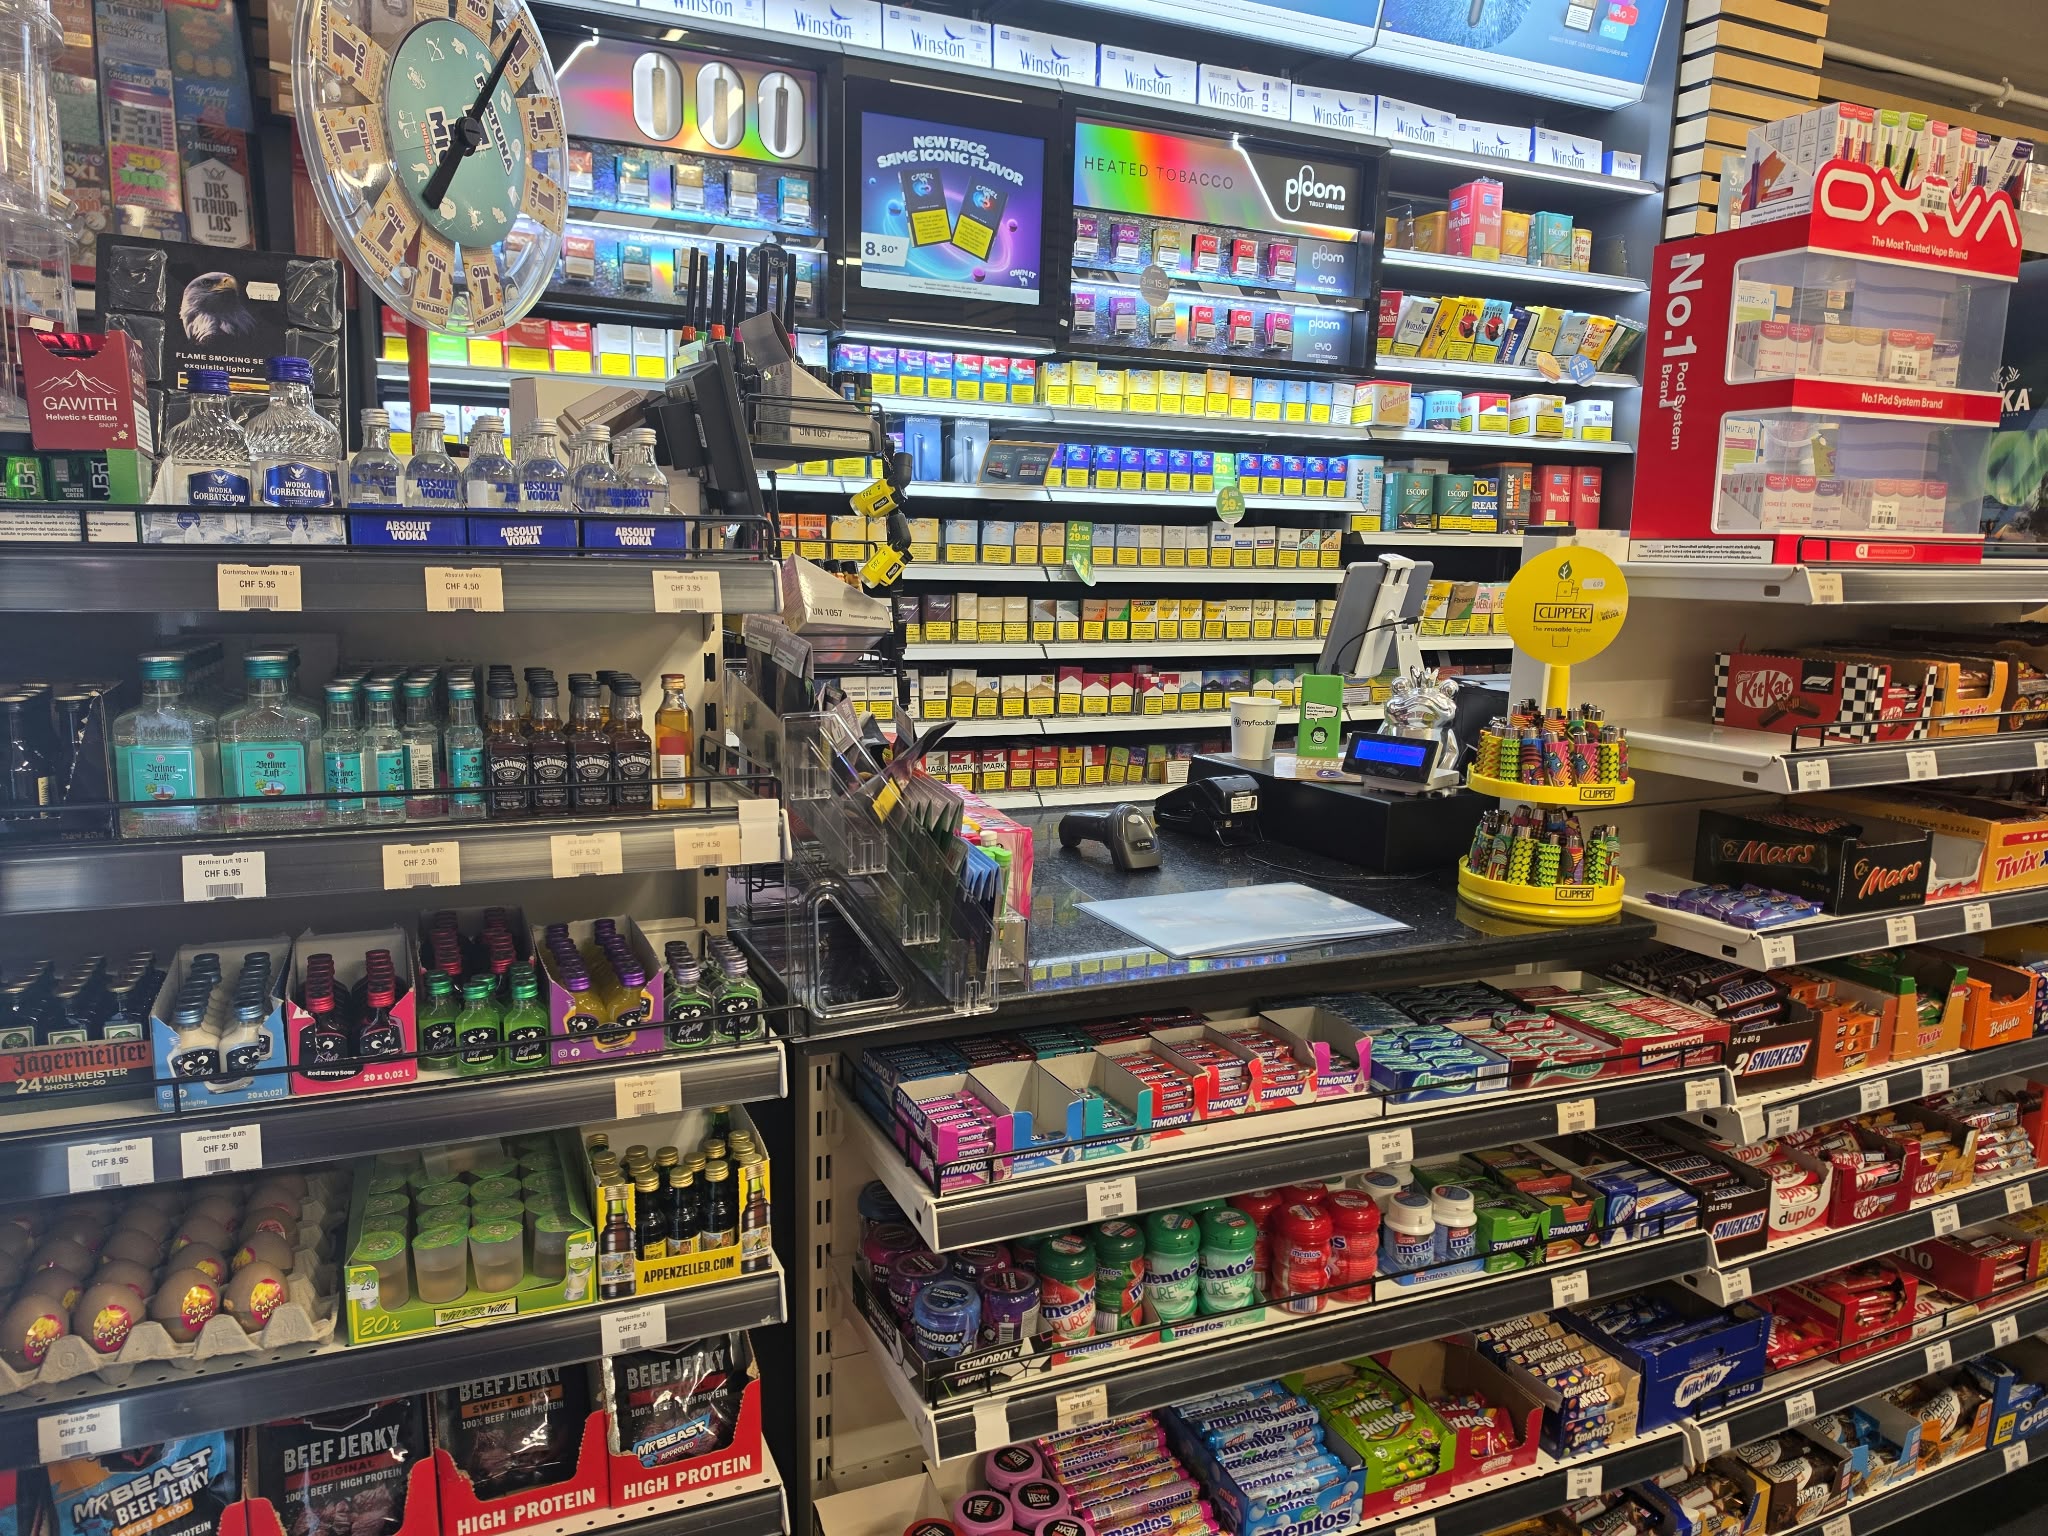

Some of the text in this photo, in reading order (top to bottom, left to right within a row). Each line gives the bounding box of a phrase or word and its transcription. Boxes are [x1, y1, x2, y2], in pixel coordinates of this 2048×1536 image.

[794, 10, 852, 39] Winston
[332, 30, 366, 78] 1 MIO
[911, 29, 965, 59] Winston
[1124, 68, 1171, 96] Winston
[1208, 83, 1254, 110] Winston
[1396, 116, 1435, 143] Winston
[187, 141, 238, 154] 2 MILLIONEN
[913, 136, 989, 159] NEW FACE,
[1552, 146, 1585, 168] Winston
[877, 150, 1024, 186] SAME ICONIC FLAVOR
[1084, 156, 1234, 190] HEATED TOBACCO
[204, 182, 229, 199] DAS
[976, 184, 998, 200] CAMEL
[192, 197, 243, 217] TRAUM-
[208, 215, 231, 233] LOS
[386, 202, 406, 234] MIO
[1871, 236, 1969, 261] The Most Trusted Vape Brand
[1028, 271, 1037, 279] IT
[1318, 275, 1336, 285] evo
[175, 352, 207, 361] FLAME
[209, 354, 249, 363] SMOKING
[184, 363, 254, 374] exquisite lighter
[1659, 364, 1675, 409] Brand
[43, 397, 118, 411] GAWITH
[1670, 362, 1689, 451] Pod System
[1861, 391, 1943, 410] No.1 Pod System Brand
[46, 413, 80, 421] Helvetic
[269, 487, 326, 499] GORBATSCHOW
[285, 481, 311, 489] WODKA
[1447, 489, 1469, 498] ESCORT
[1506, 474, 1515, 510] BLACK
[193, 491, 246, 503] GORBATSCHOW
[386, 521, 431, 532] ABSOLUT
[390, 529, 427, 541] VODKA
[500, 525, 543, 537] ABSOLUT
[615, 526, 656, 537] ABSOLUT
[1071, 524, 1078, 532] 4
[505, 535, 540, 546] VODKA
[619, 536, 652, 546] VODKA
[1069, 533, 1090, 541] 29.90
[239, 580, 276, 589] CHF 5.95
[812, 608, 842, 617] UN 1057
[1539, 607, 1587, 619] CLIPPER
[1741, 672, 1791, 708] KitKat
[534, 759, 546, 770] JACK
[950, 763, 973, 772] MARK
[983, 762, 1006, 771] MARK
[1583, 789, 1613, 798] CLIPPER
[403, 858, 438, 867] CHF 2.50
[1738, 840, 1817, 865] Mars
[204, 868, 241, 878] CHF 6.95
[1996, 850, 2040, 882] Twix
[1859, 861, 1922, 899] Mars
[1559, 890, 1591, 898] CLIPPER
[1989, 1015, 2021, 1038] Balisto
[1917, 1028, 1943, 1046] Twix
[13, 1041, 146, 1076] Jägermeister
[862, 1051, 893, 1082] STIMOROL
[1734, 1044, 1807, 1076] 2 SNICKERS
[15, 1067, 128, 1094] 24 MINI MEISTER
[44, 1078, 106, 1092] SHOTS-TO-GO
[896, 1092, 925, 1125] STIMOROL
[91, 1156, 129, 1168] CHF 8.95
[1779, 1206, 1817, 1225] duplo
[1714, 1214, 1762, 1240] SNICKERS
[643, 1256, 734, 1284] APPENZELLER.COM
[1143, 1256, 1199, 1283] mentos
[618, 1322, 647, 1334] CHF 2.50
[915, 1324, 959, 1343] STIMOROL
[1053, 1315, 1087, 1332] PURE
[918, 1341, 950, 1352] INFINITY
[1524, 1340, 1567, 1364] SMARTIES
[1541, 1351, 1584, 1376] SMARTIES
[459, 1366, 562, 1401] BEEF JERKY
[472, 1389, 553, 1414] SWEET & HOT
[59, 1423, 96, 1437] CHF 2.50
[1357, 1409, 1415, 1441] Skittles
[1574, 1420, 1615, 1446] SMARTIES
[283, 1424, 401, 1473] BEEF JERKY
[660, 1440, 694, 1461] APPROVED
[310, 1461, 375, 1482] ORIGINAL
[623, 1454, 752, 1500] HIGH PROTEIN
[116, 1469, 209, 1526] BEEF JERKY
[1330, 1493, 1353, 1509] mint
[1393, 1482, 1426, 1502] Skittles
[457, 1488, 596, 1536] HIGH PROTEIN
[1104, 1515, 1173, 1536] mentos
[1259, 1509, 1351, 1536] mentos
